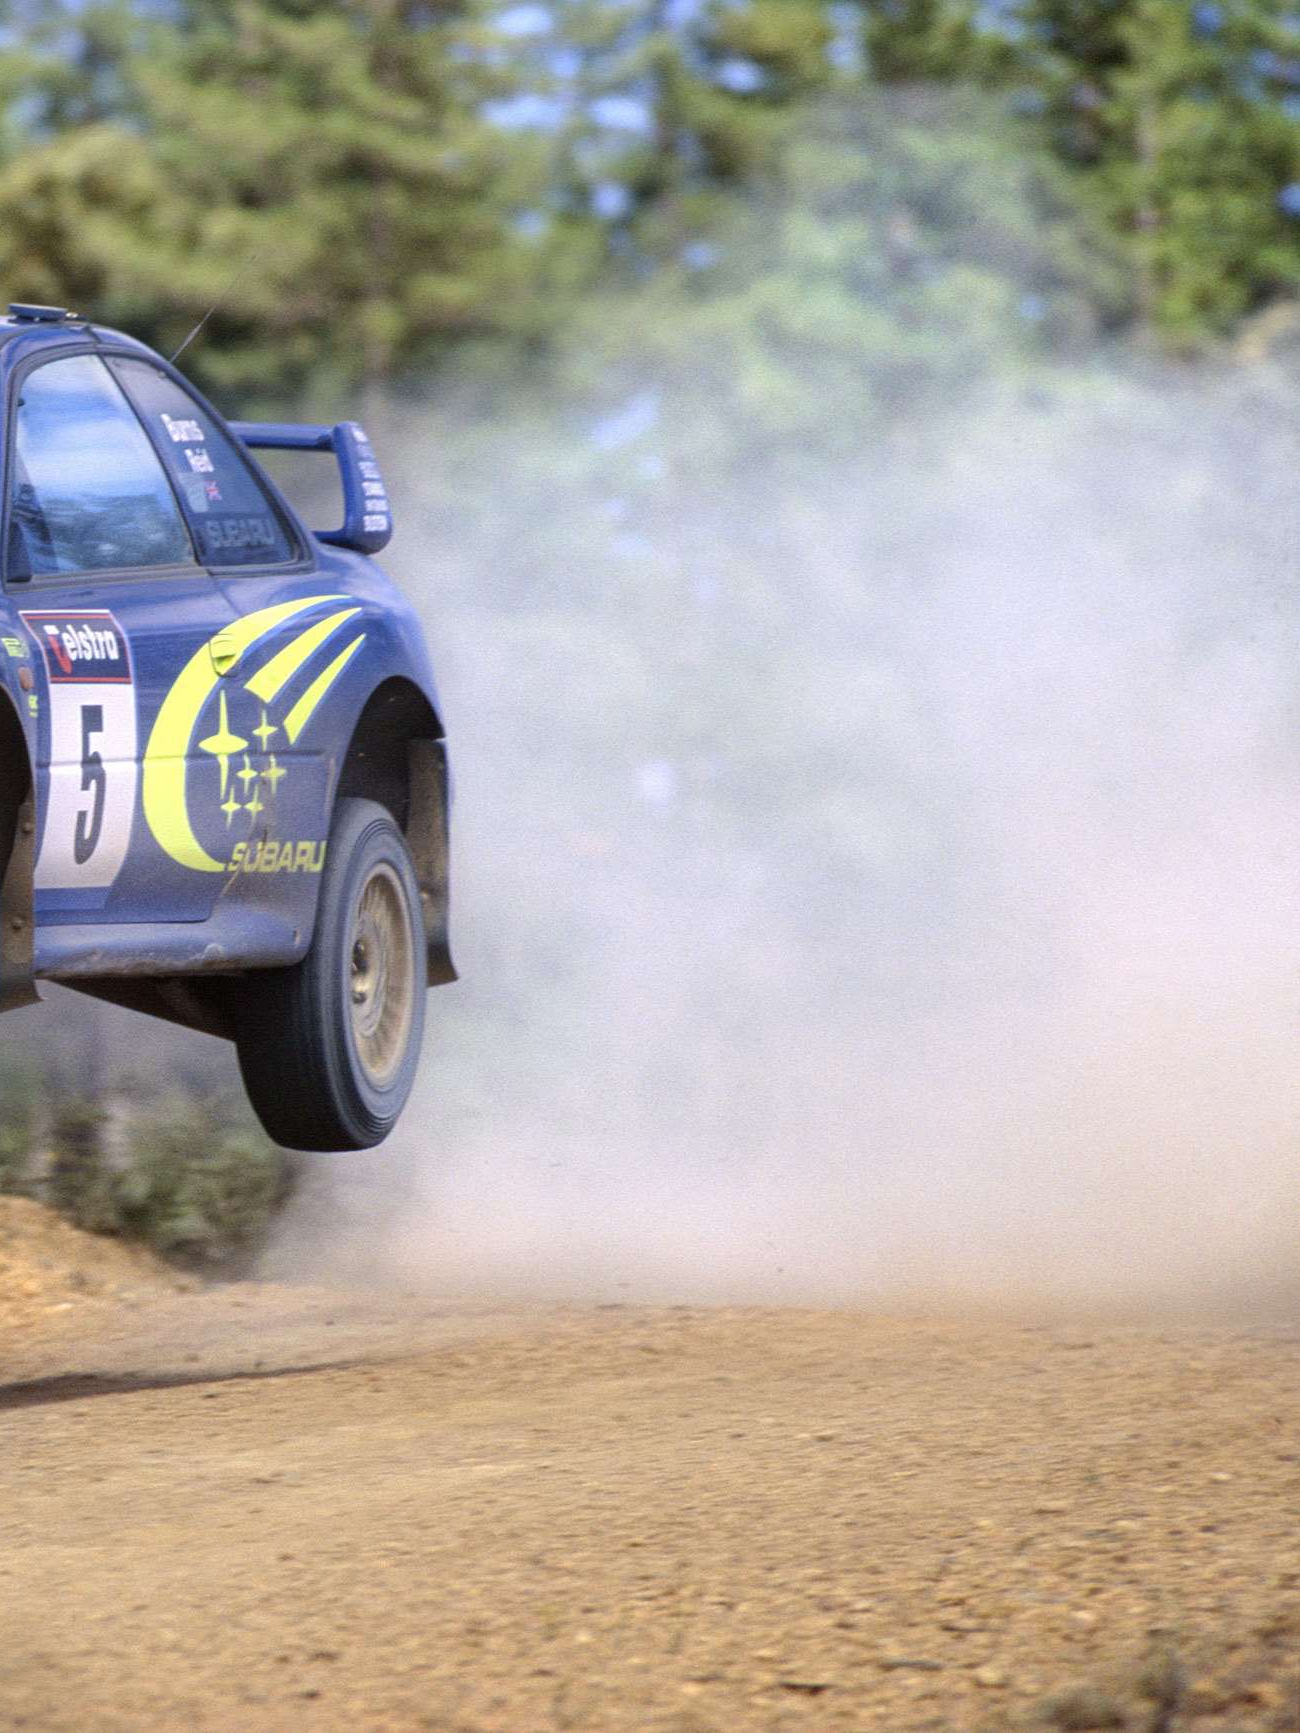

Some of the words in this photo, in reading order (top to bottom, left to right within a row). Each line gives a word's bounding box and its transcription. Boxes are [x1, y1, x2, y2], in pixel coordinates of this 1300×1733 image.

[43, 624, 119, 674] Telstra
[74, 704, 107, 865] 5
[227, 841, 328, 873] SUBARU
